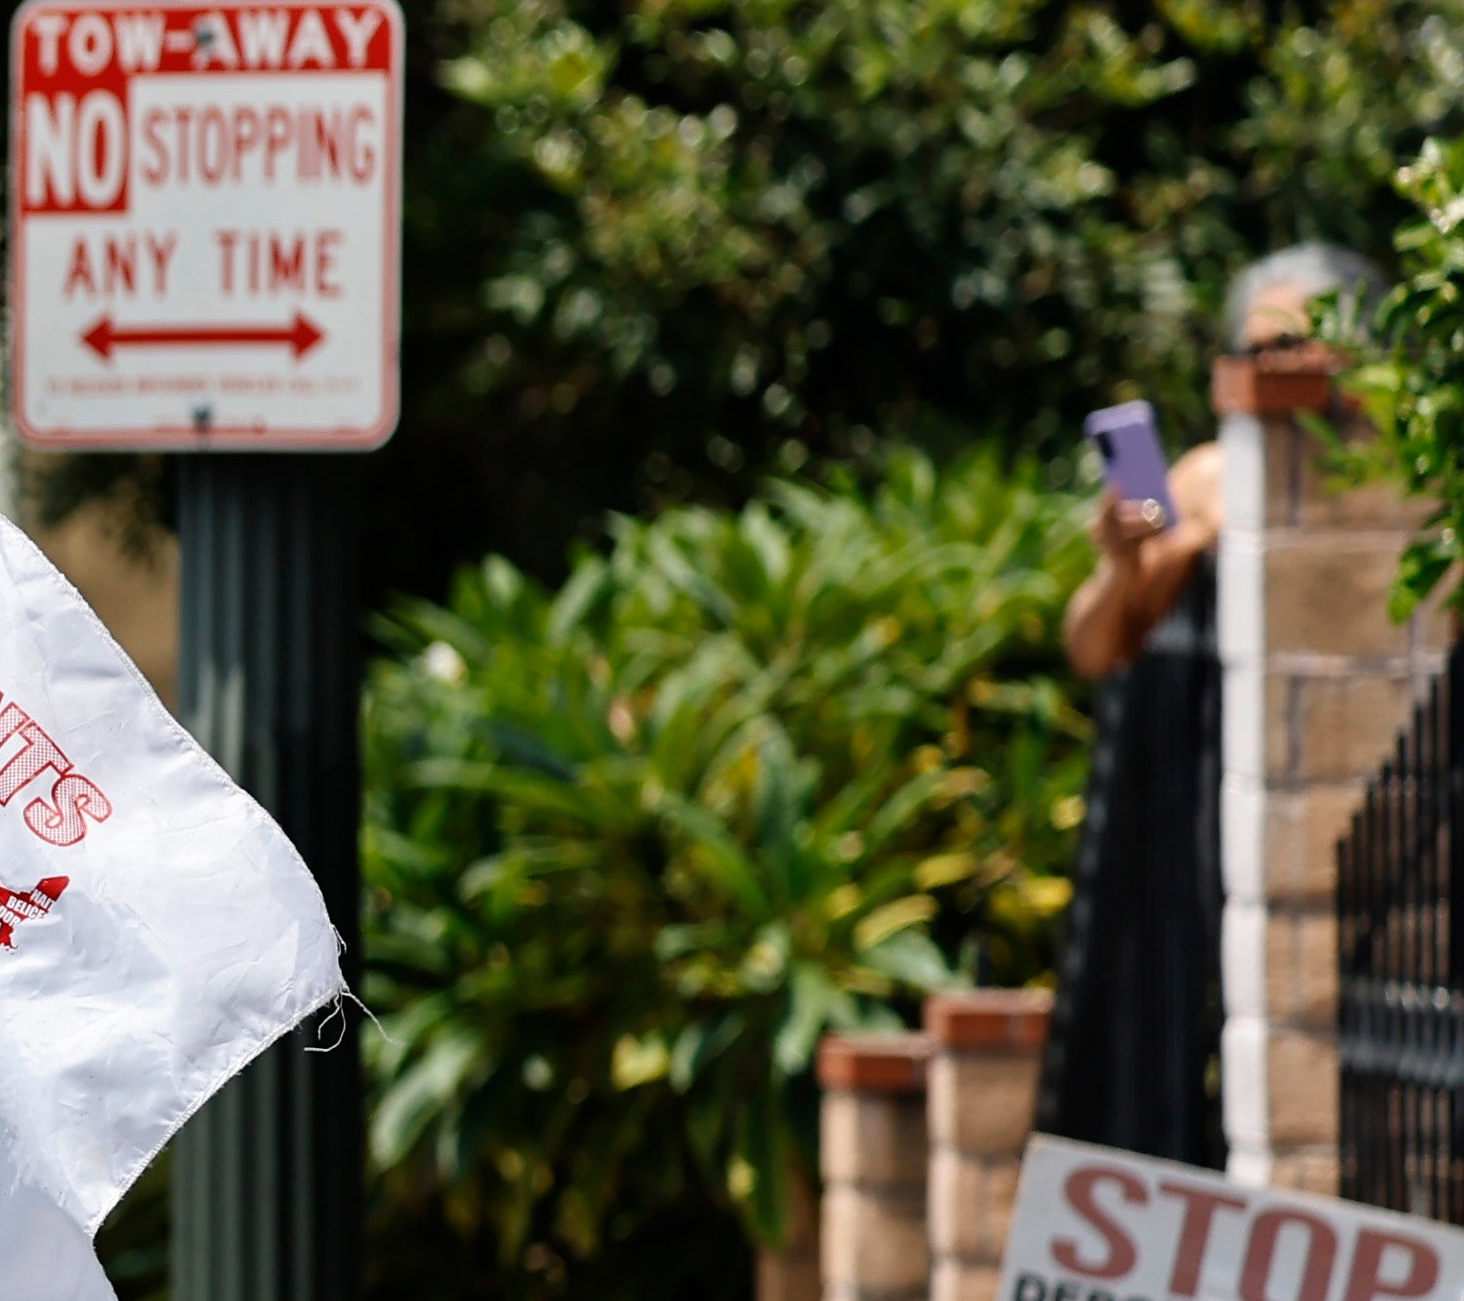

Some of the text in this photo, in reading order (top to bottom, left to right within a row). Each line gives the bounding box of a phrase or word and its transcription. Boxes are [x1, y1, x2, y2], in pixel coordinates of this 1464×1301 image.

[33, 8, 384, 76] TOW-AWAY
[27, 91, 375, 209] NO STOPPING
[63, 230, 346, 302] ANY TIME
